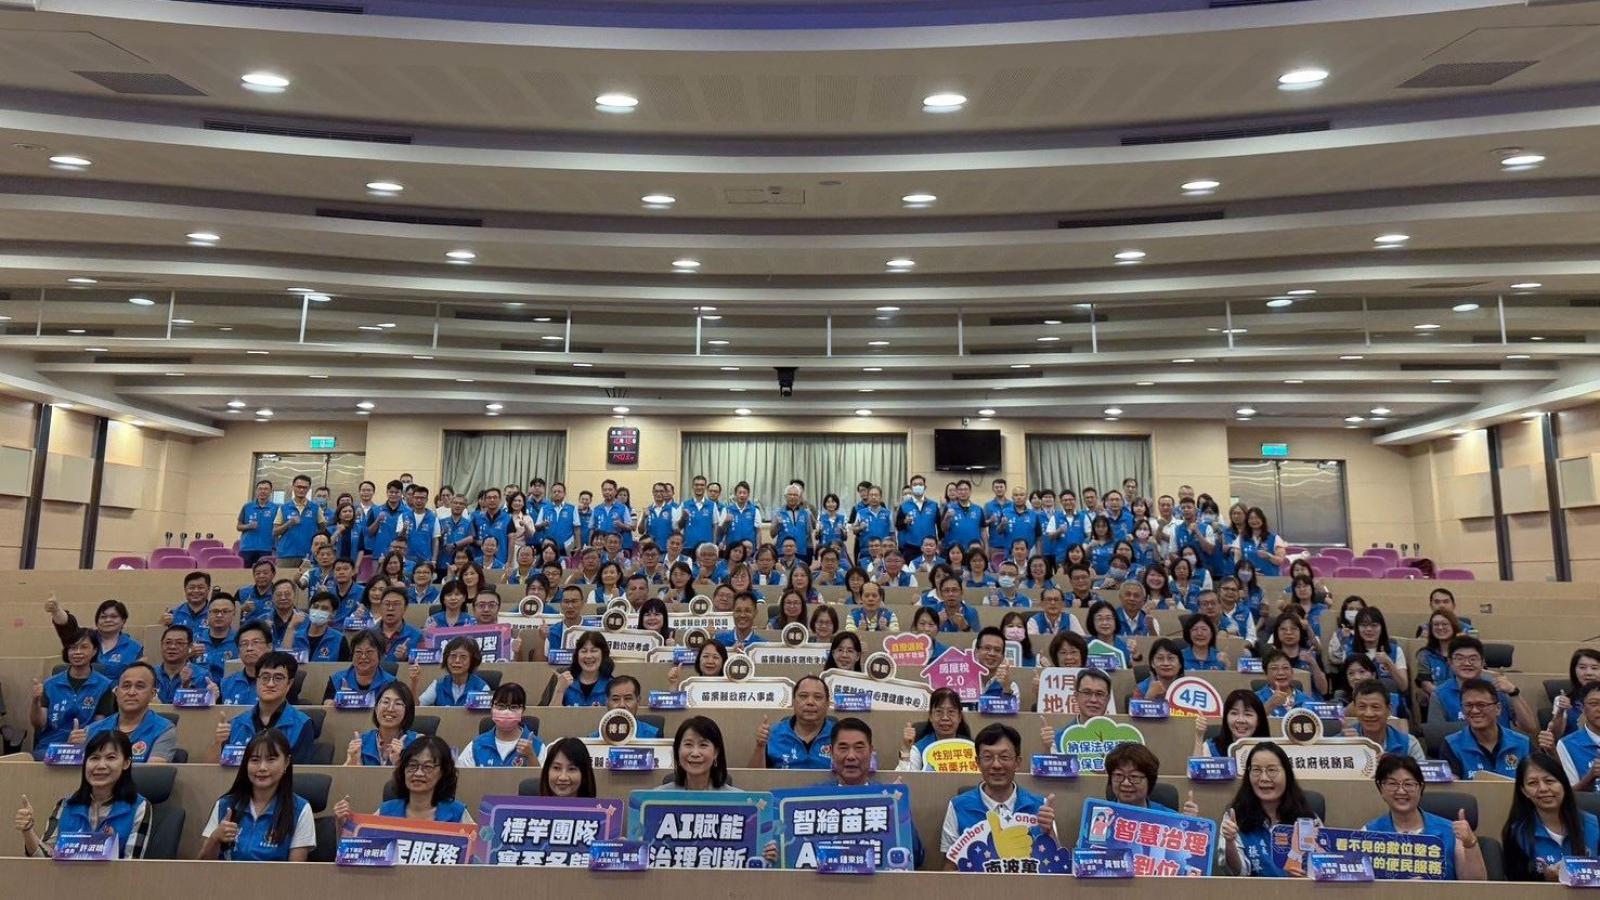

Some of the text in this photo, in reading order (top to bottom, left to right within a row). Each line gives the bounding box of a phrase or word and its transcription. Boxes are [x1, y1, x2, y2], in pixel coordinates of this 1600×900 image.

[946, 675, 965, 686] 2.0
[701, 691, 775, 702] 苗栗縣政府人事處
[1179, 688, 1208, 709] 4月
[932, 748, 974, 760] 性別平等
[1067, 740, 1114, 753] 納保法保
[656, 813, 744, 840] AI賦能
[793, 806, 888, 835] 智繪苗栗
[1015, 814, 1038, 824] one
[501, 817, 599, 845] 標竿團隊
[949, 822, 985, 860] Number
[1114, 817, 1209, 857] 智慧治理
[650, 846, 747, 869] 治理創新
[1336, 838, 1442, 858] 看不見的數位整合
